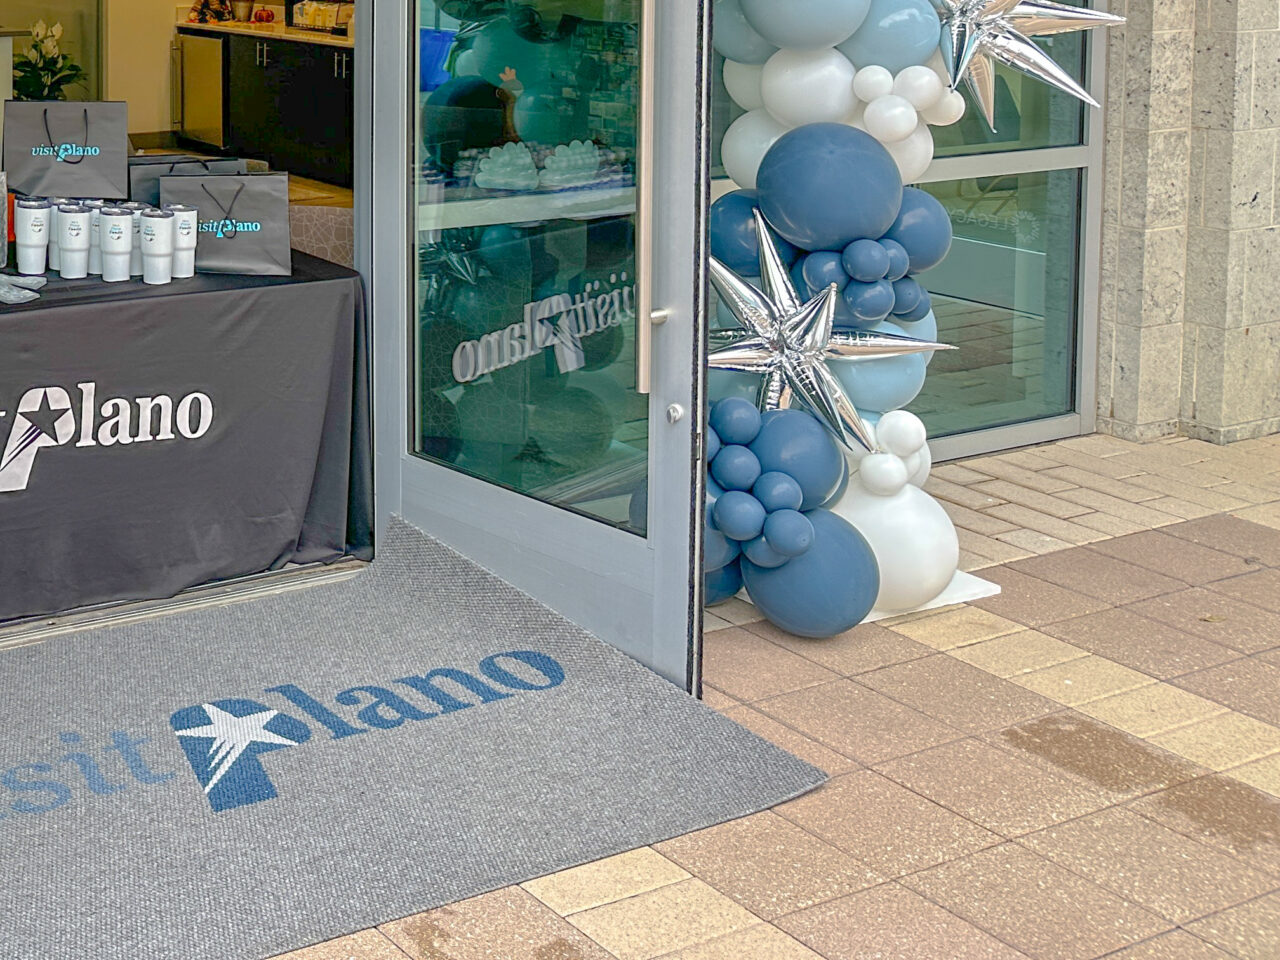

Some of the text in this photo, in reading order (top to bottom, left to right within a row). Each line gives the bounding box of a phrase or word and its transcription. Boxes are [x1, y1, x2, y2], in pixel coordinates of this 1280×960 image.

[32, 144, 100, 162] visit Plano
[198, 220, 218, 232] isit
[169, 650, 566, 813] Plano
